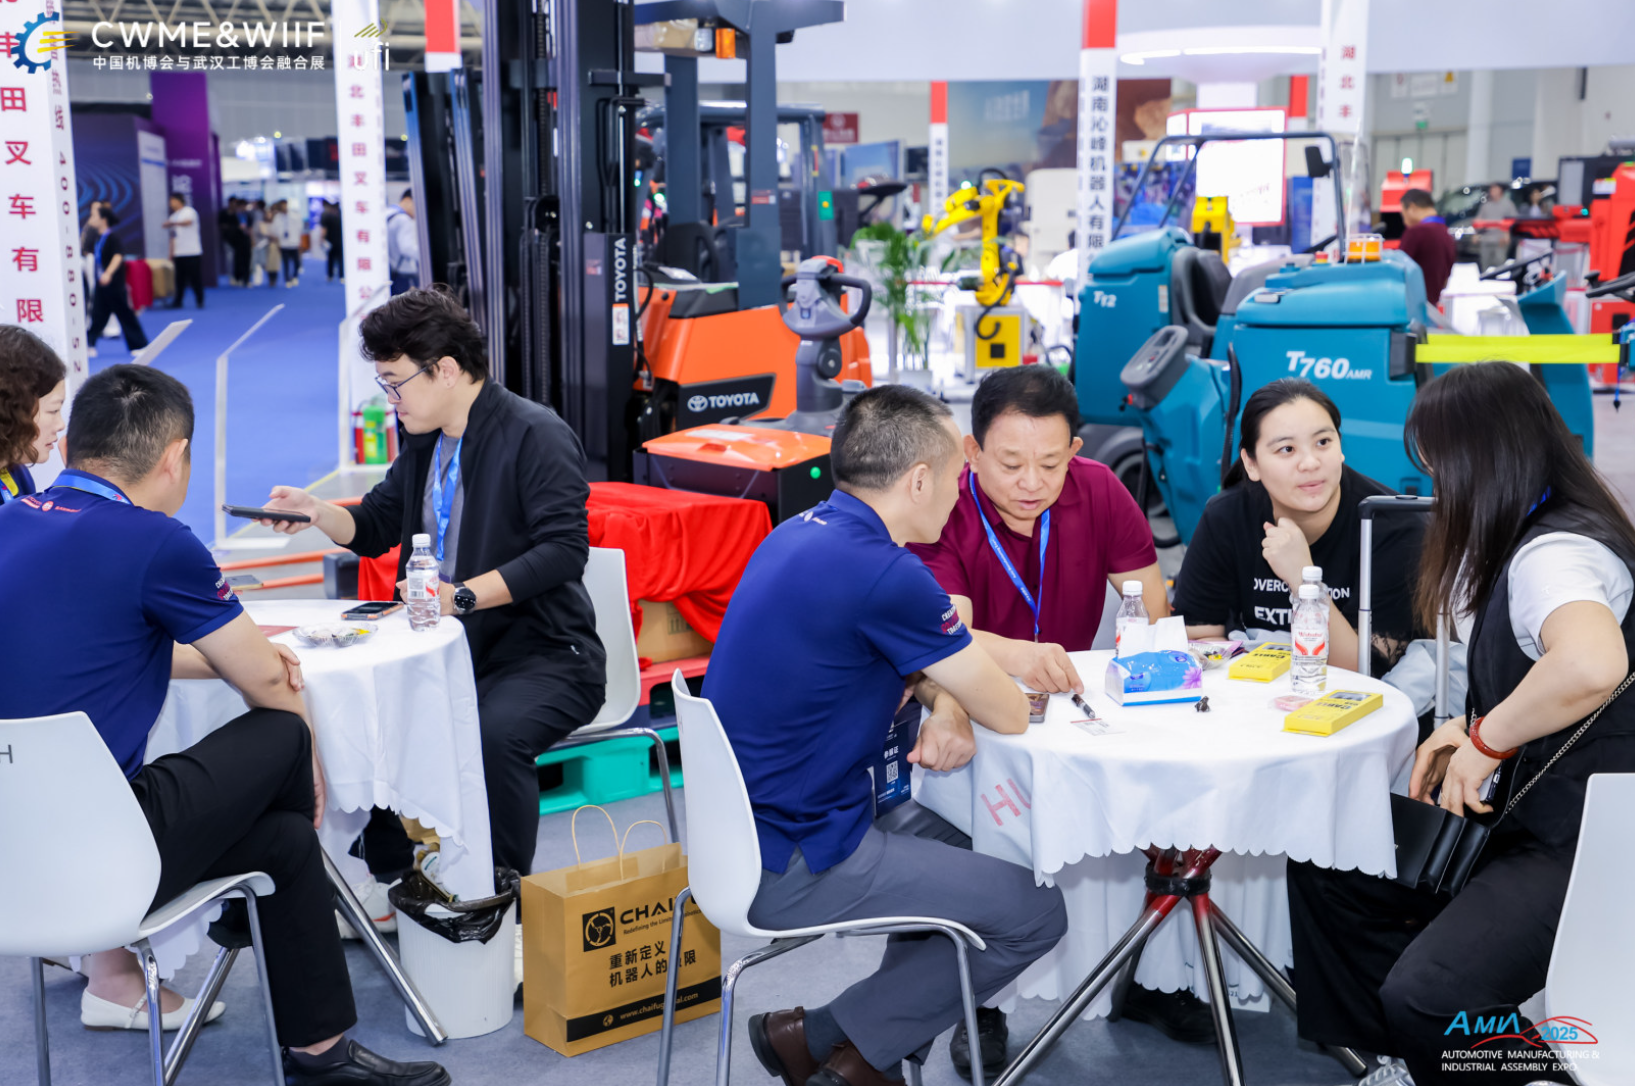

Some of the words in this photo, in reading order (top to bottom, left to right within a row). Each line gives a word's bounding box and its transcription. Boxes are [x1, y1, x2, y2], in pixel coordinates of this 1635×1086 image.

[614, 237, 627, 302] TOYOTA
[708, 392, 759, 409] TOYOTA
[650, 919, 658, 928] the
[609, 940, 667, 970] 重新定义
[609, 949, 697, 988] 机器人的限
